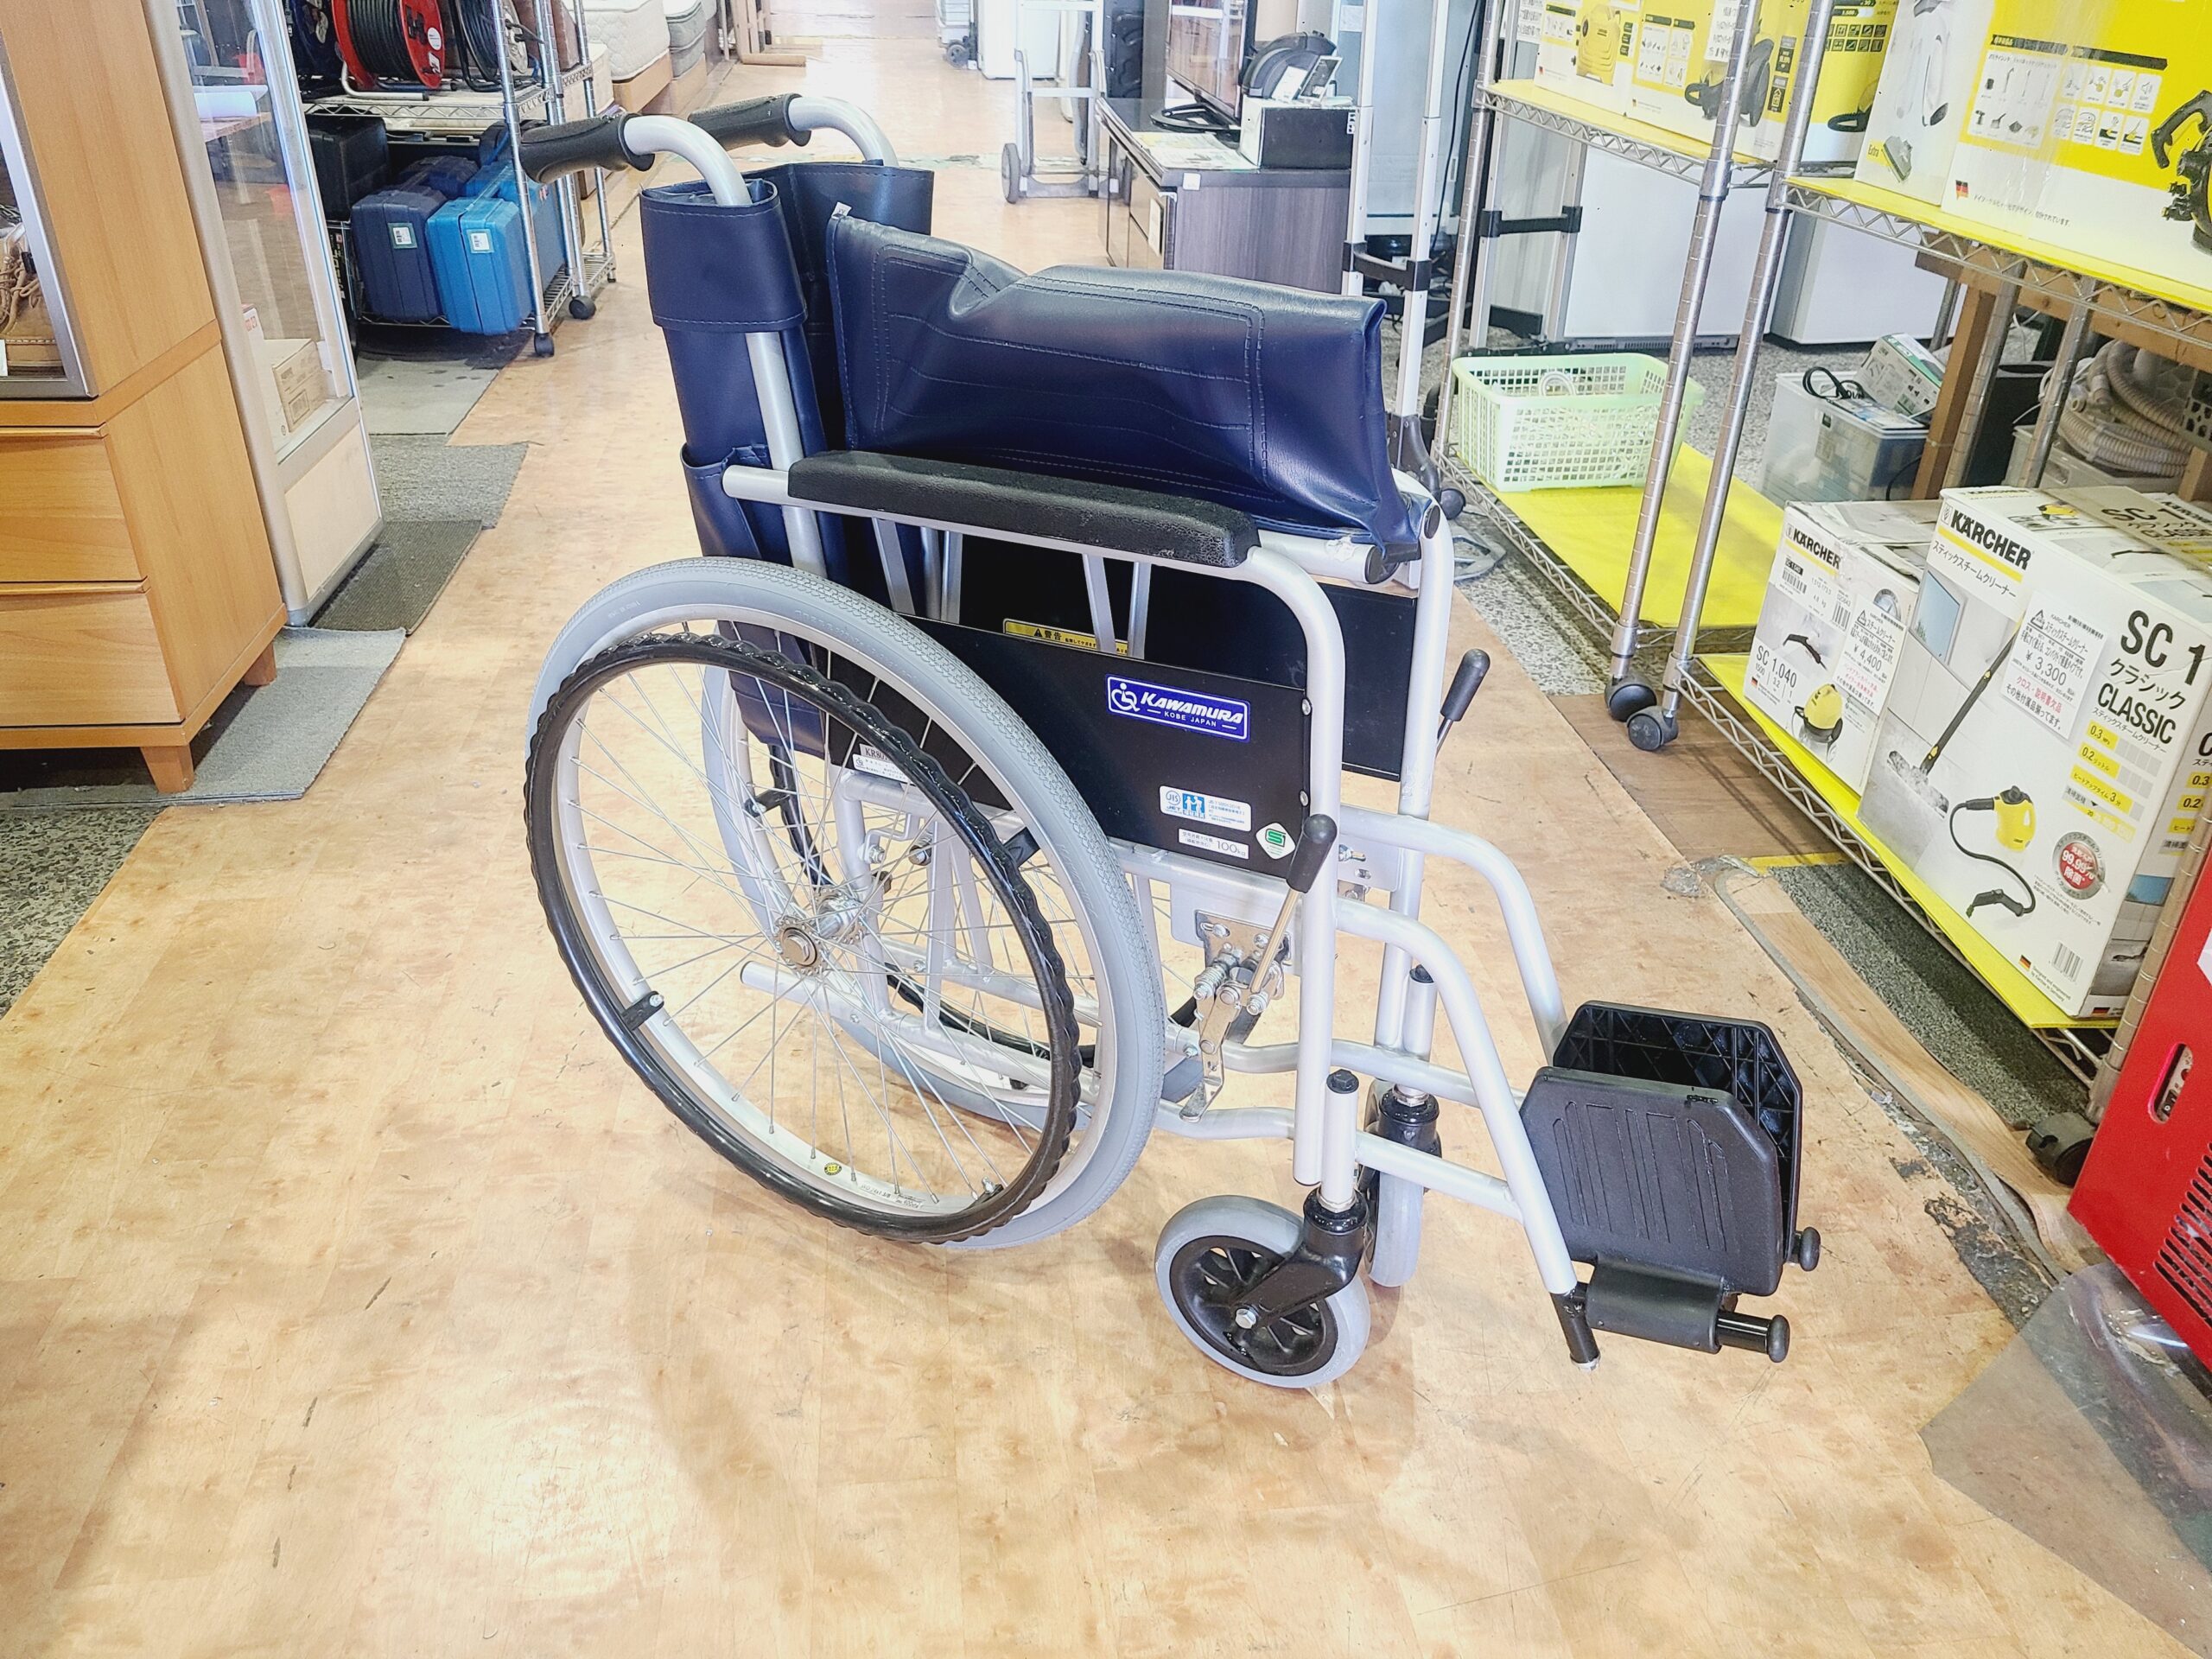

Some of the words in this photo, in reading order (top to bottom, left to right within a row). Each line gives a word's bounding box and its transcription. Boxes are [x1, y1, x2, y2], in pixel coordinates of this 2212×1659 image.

[1868, 144, 1878, 157] Extra
[1793, 529, 1841, 569] KÄRCHER
[1951, 510, 2031, 570] KÄRCHER
[1933, 541, 2016, 597] スティックスチームクリーナー
[1044, 630, 1062, 641] 警告
[2120, 610, 2173, 667] SC
[2184, 645, 2205, 685] 1
[1757, 645, 1769, 665] SC
[1771, 658, 1797, 688] 1.040
[1859, 647, 1882, 671] 4,400
[2034, 657, 2066, 686] 3,300
[2111, 658, 2185, 709] クラシック
[1141, 691, 1243, 724] KAWAMURA
[1164, 710, 1186, 721] KOBE
[1191, 716, 1217, 727] JAPAN
[2098, 683, 2176, 744] CLASSIC
[2091, 726, 2102, 739] 0.3
[2093, 708, 2166, 753] スティックスチームクリーナー
[2082, 747, 2094, 761] 0.2
[2074, 772, 2108, 798] ヒートアップタイム
[2109, 792, 2117, 802] 3
[2192, 775, 2210, 785] 0.3
[1166, 794, 1179, 803] JIS
[2183, 798, 2201, 809] 0.2
[1217, 840, 1246, 856] 100kg
